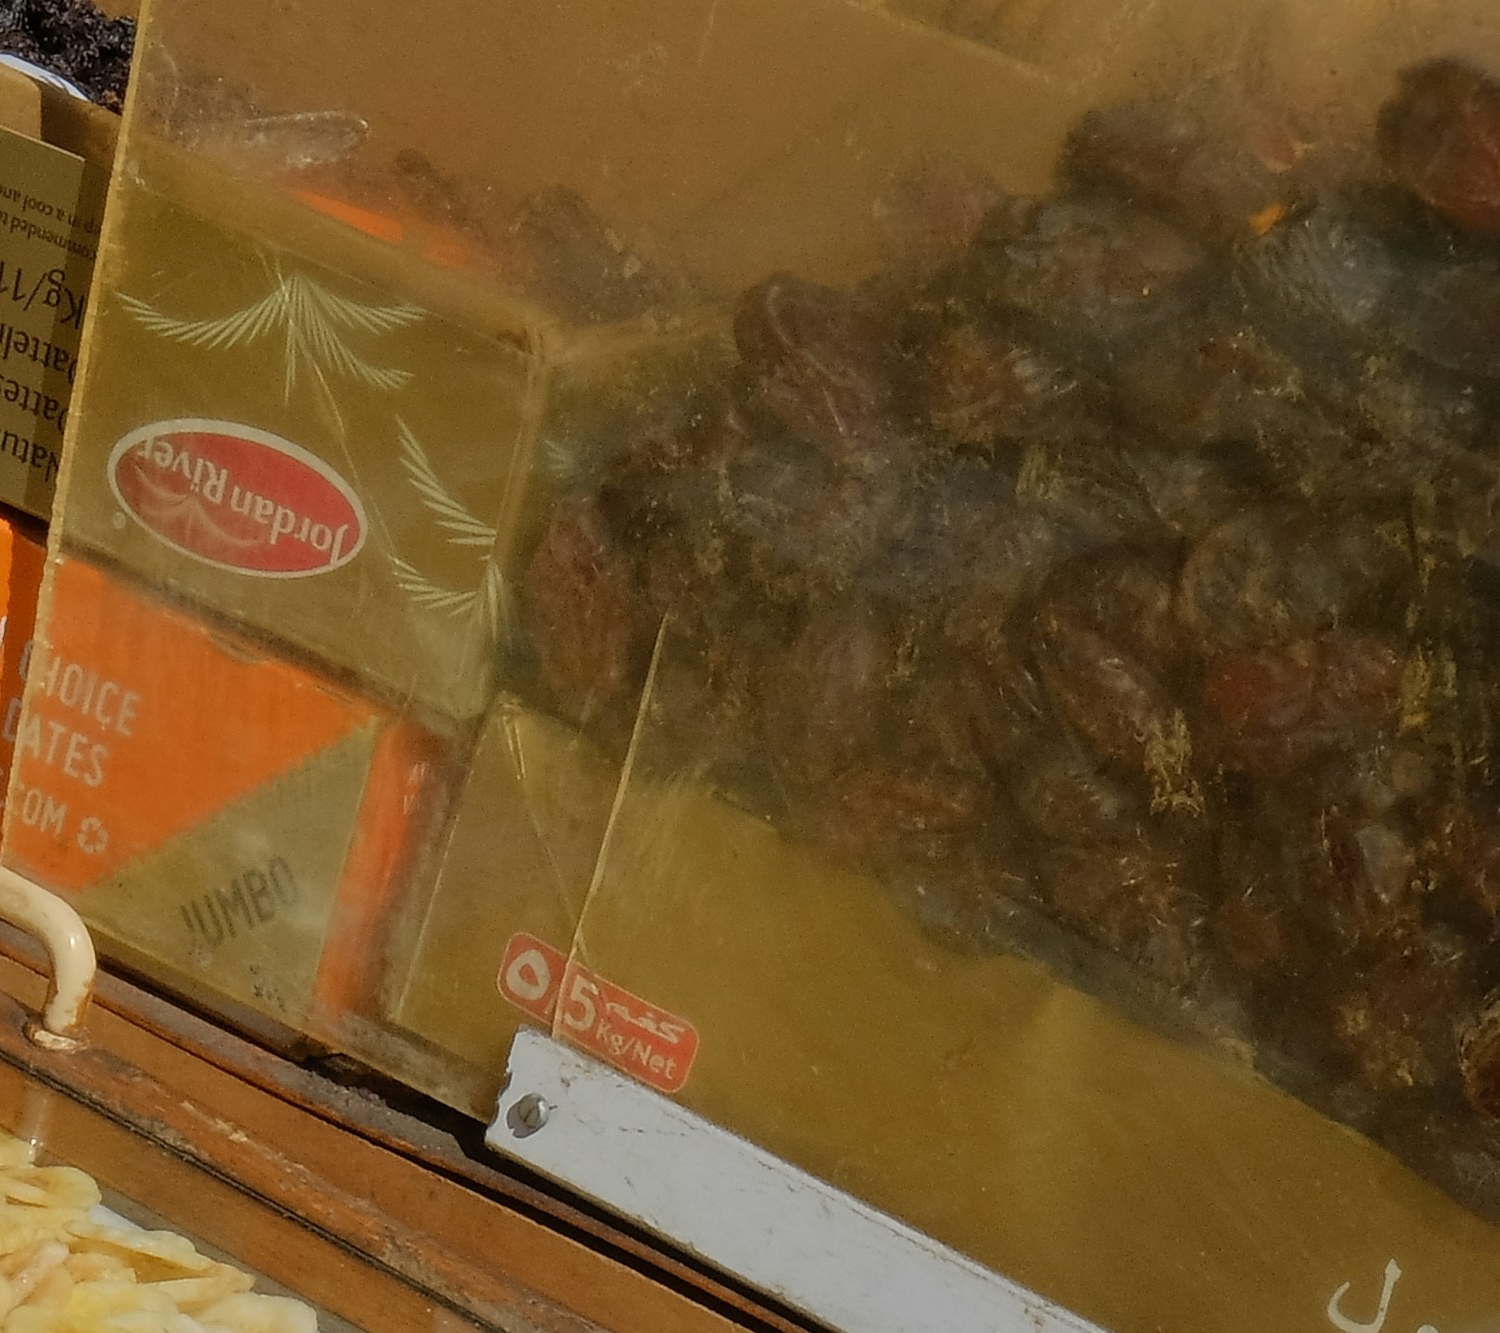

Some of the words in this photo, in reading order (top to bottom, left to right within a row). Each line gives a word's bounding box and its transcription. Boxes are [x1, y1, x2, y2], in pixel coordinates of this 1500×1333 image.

[134, 436, 229, 506] River
[229, 484, 349, 565] Jordan
[18, 638, 141, 737] CHOICE
[2, 697, 110, 788] DATES
[596, 1017, 677, 1080] Kg/Net
